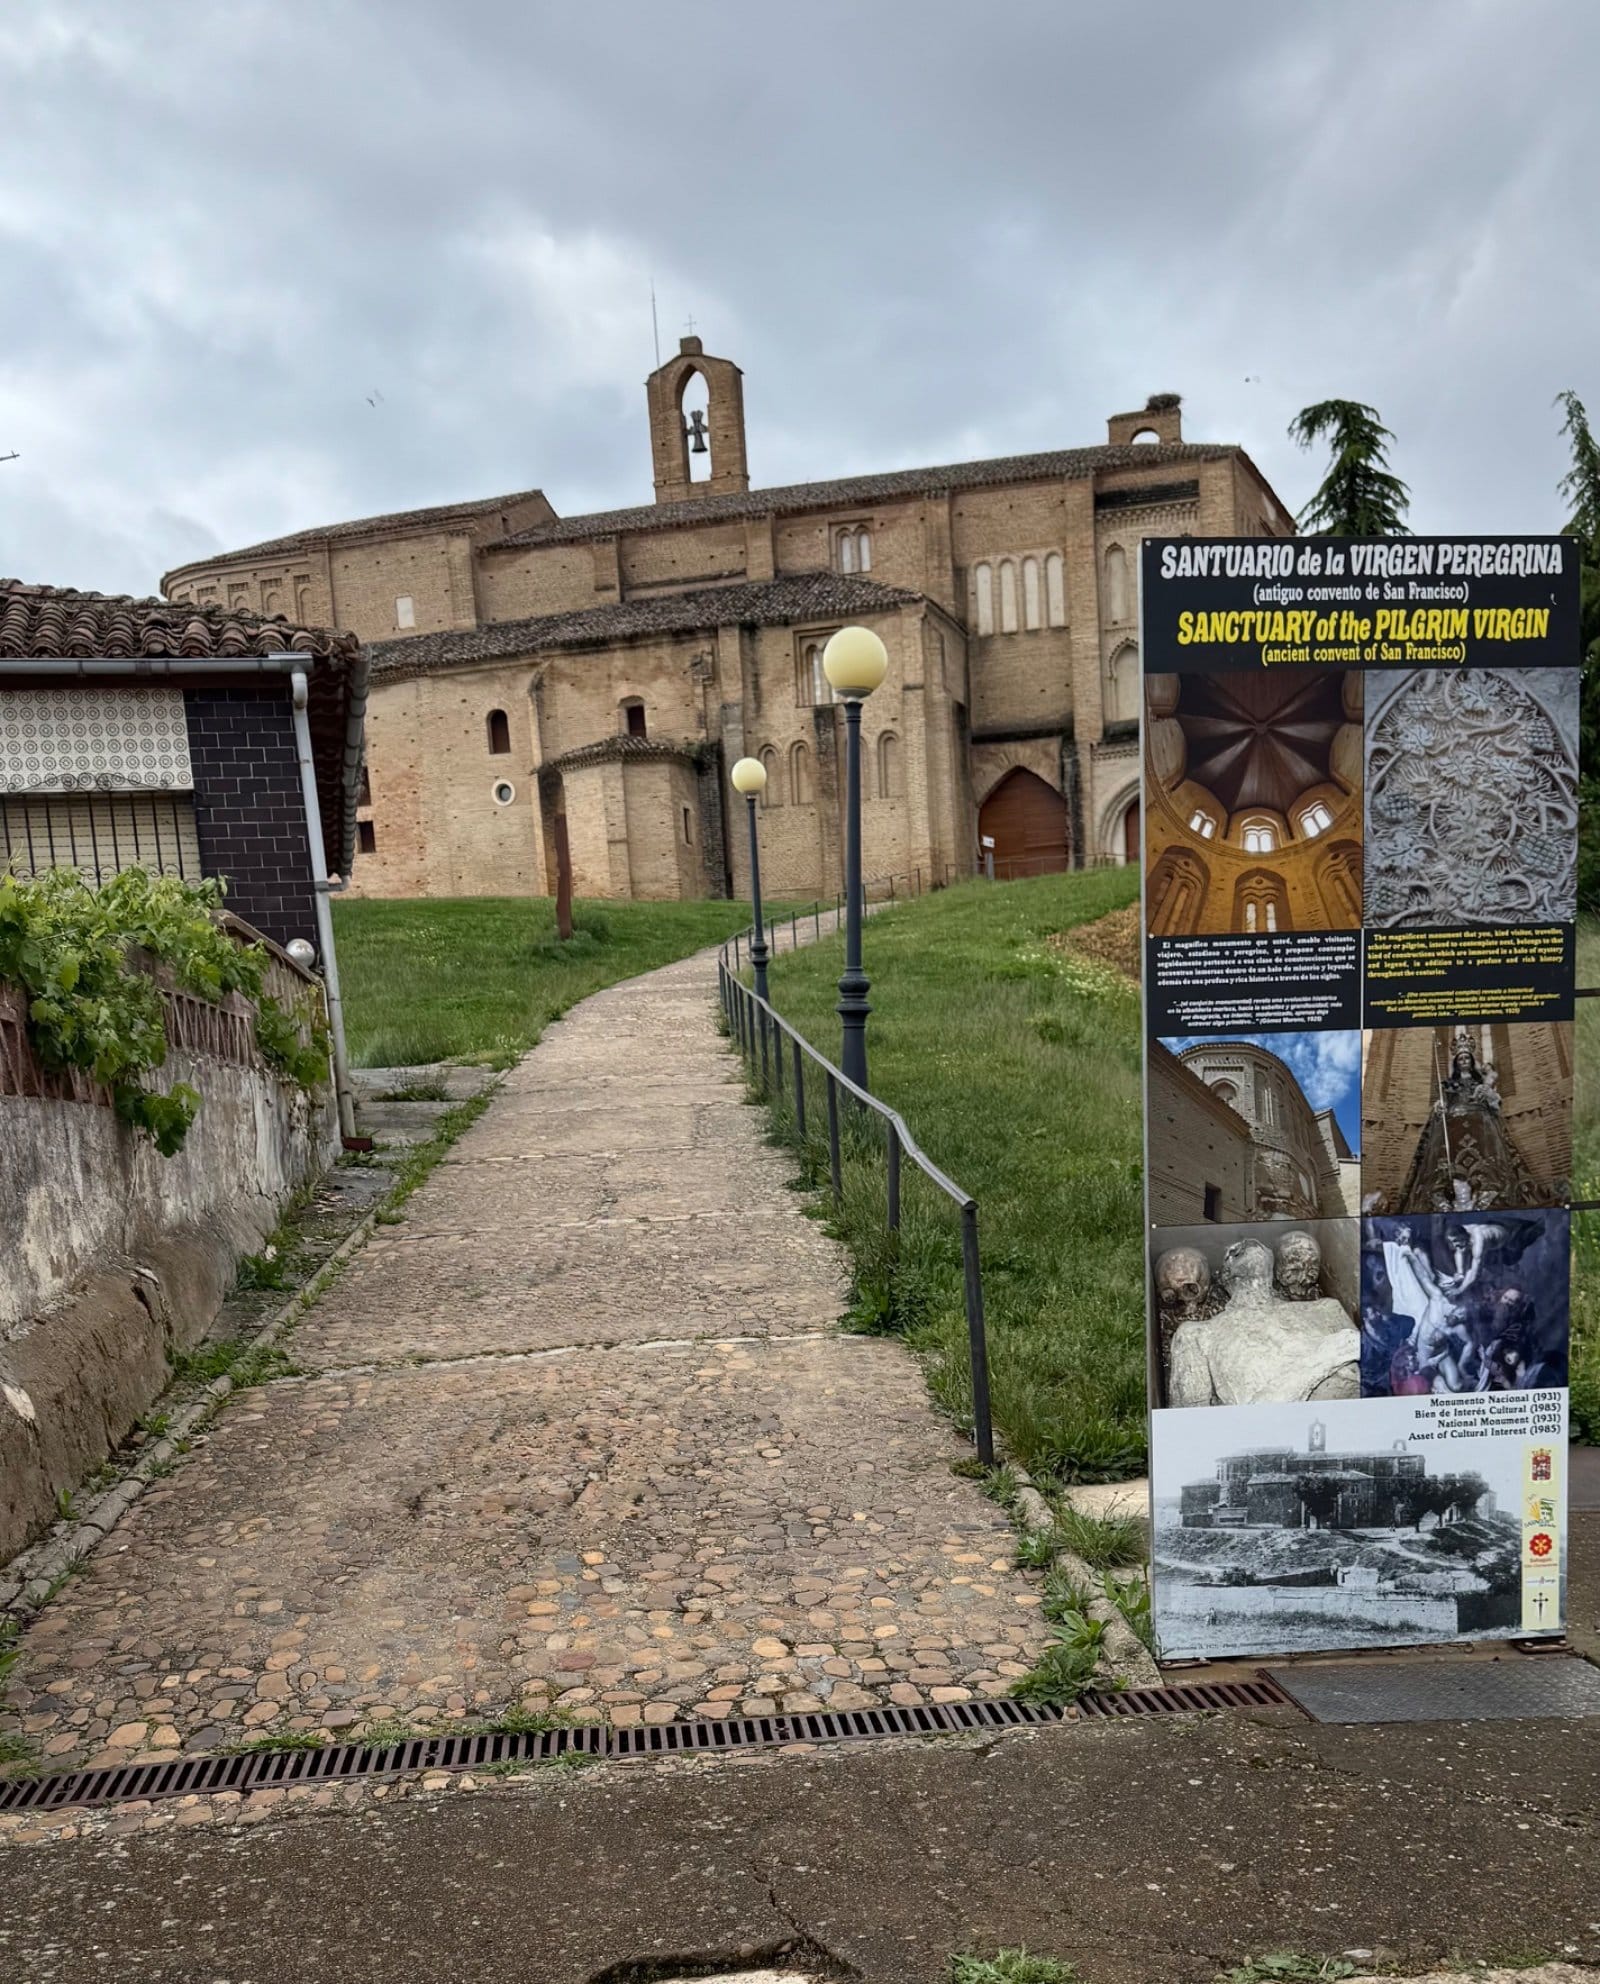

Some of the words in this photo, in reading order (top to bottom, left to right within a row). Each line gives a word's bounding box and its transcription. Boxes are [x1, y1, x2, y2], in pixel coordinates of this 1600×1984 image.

[1160, 544, 1295, 579] SANTUARIO
[1297, 546, 1322, 576] de
[1324, 546, 1345, 576] la
[1349, 544, 1435, 578] VIRGEN
[1436, 543, 1564, 578] PEREGRINA
[1253, 582, 1304, 606] (antiguo
[1307, 585, 1361, 601] convento
[1365, 583, 1379, 600] de
[1383, 583, 1405, 600] San
[1408, 581, 1469, 604] Francisco)
[1176, 610, 1318, 645] SANCTUARY
[1316, 611, 1339, 642] of
[1340, 610, 1371, 643] the
[1374, 608, 1470, 642] PILGRIM
[1473, 607, 1550, 641] VIRGIN
[1261, 644, 1310, 667] (ancient
[1313, 646, 1361, 663] convent
[1364, 644, 1378, 661] of
[1381, 644, 1402, 661] San
[1405, 641, 1466, 664] Francisco)
[1430, 1397, 1485, 1407] Monumento
[1488, 1394, 1529, 1404] Nacional
[1532, 1392, 1561, 1403] (1931)
[1415, 1410, 1436, 1418] Bien
[1439, 1409, 1450, 1417] de
[1454, 1406, 1486, 1416] Interés
[1489, 1405, 1526, 1415] Cultural
[1530, 1403, 1561, 1413] (1985)
[1437, 1419, 1477, 1428] National
[1480, 1417, 1529, 1426] Monument
[1532, 1414, 1561, 1424] (1931)
[1408, 1432, 1434, 1440] Asset
[1437, 1430, 1447, 1439] of
[1450, 1428, 1488, 1438] Cultural
[1491, 1427, 1526, 1436] Interest
[1529, 1425, 1561, 1435] (1985)
